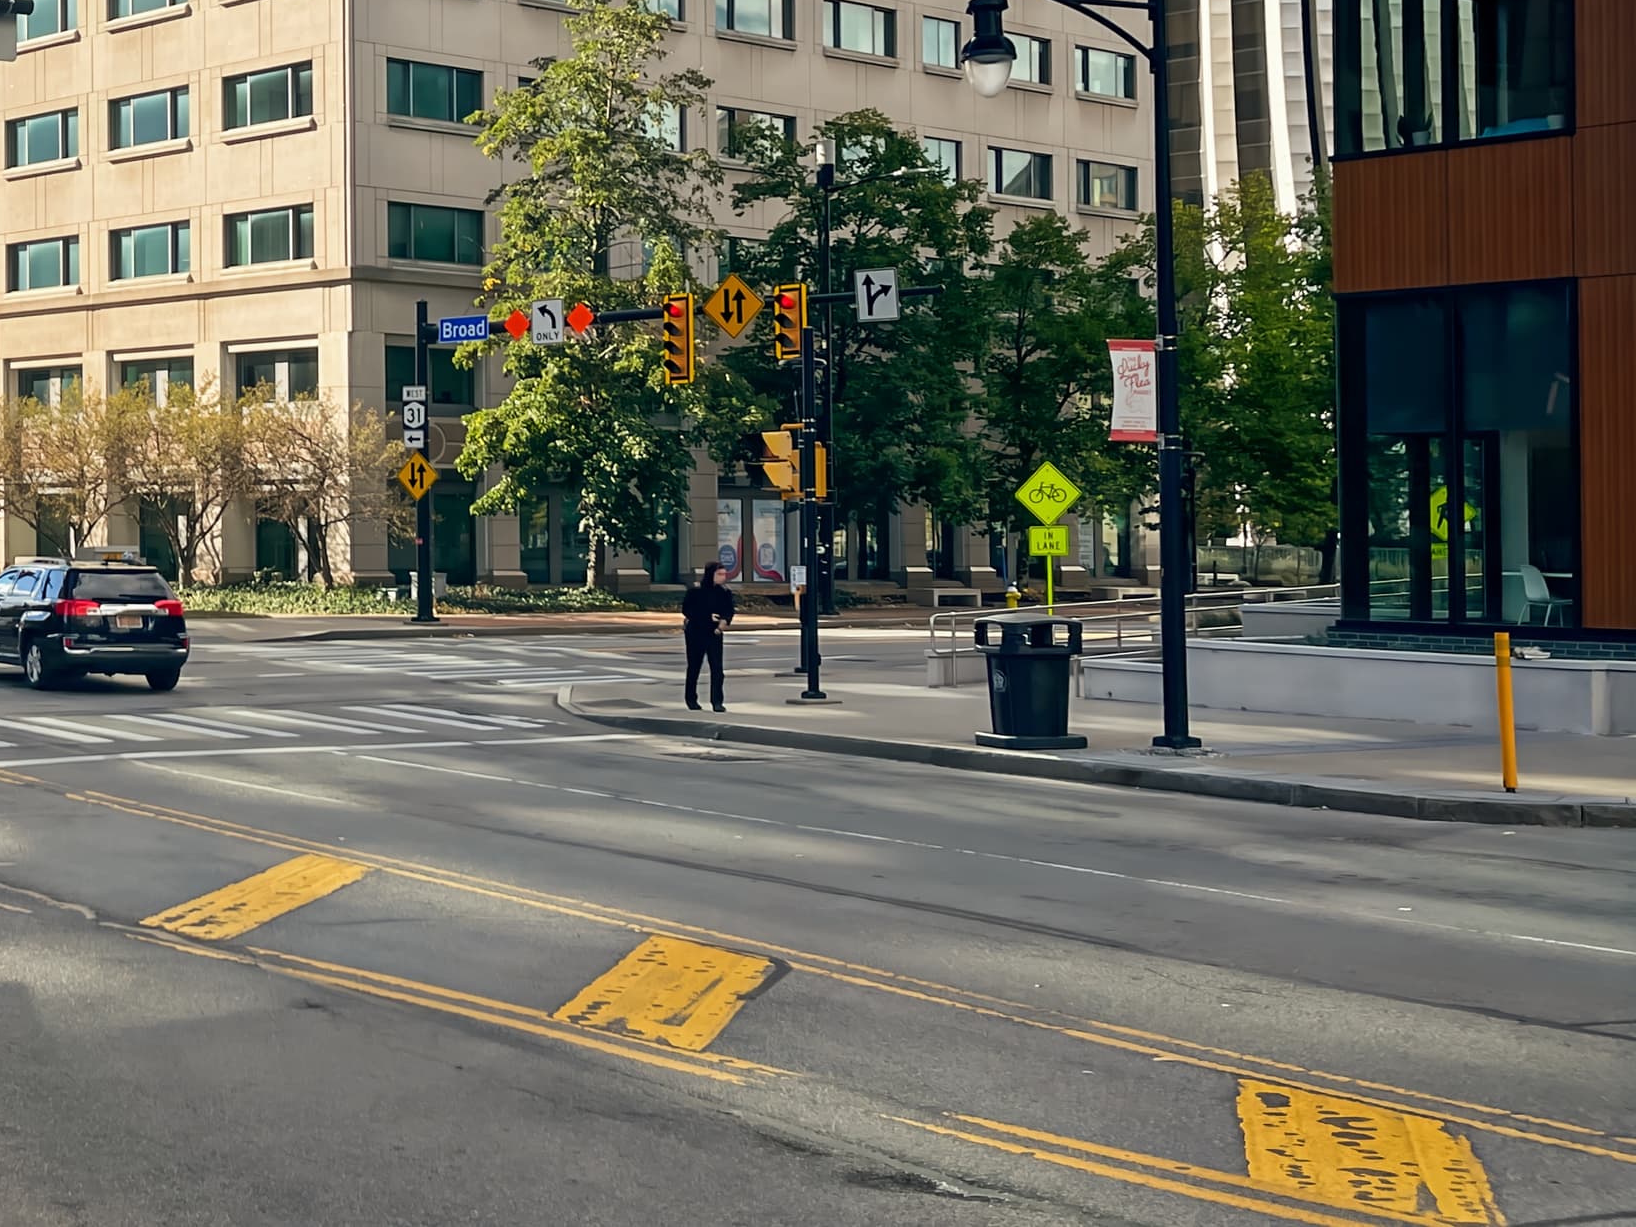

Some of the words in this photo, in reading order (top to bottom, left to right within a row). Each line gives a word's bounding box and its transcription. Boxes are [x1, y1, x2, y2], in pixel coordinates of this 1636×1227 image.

[443, 320, 485, 338] Broad
[536, 332, 560, 341] ONLY
[406, 390, 423, 398] WEST
[407, 408, 421, 423] 31
[1037, 541, 1060, 550] LANE
